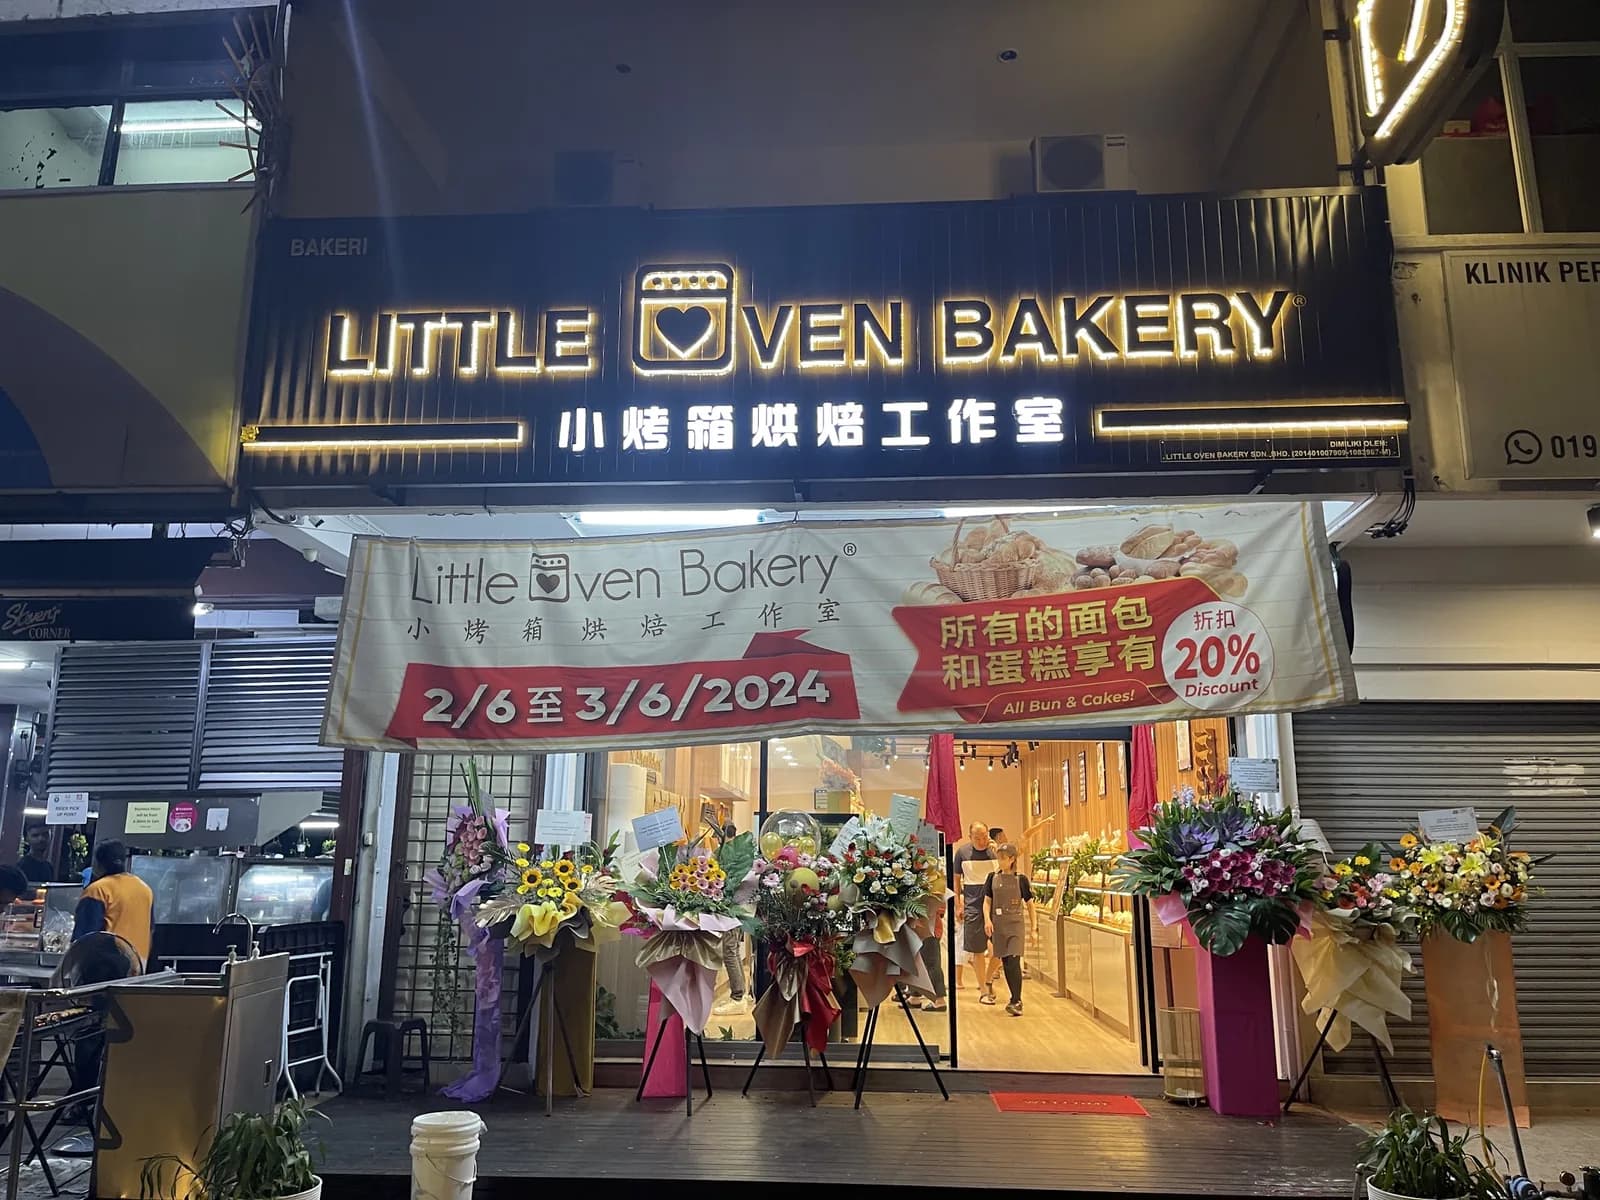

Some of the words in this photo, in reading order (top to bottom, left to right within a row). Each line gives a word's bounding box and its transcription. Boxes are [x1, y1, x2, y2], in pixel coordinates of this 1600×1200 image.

[290, 237, 368, 257] BAKERI
[1465, 261, 1551, 284] KLINIK
[327, 307, 592, 375] LITTLE
[558, 397, 1064, 452] 小烤箱烘焙工作室
[1165, 452, 1192, 460] LITTLE
[1193, 452, 1216, 460] OVEN
[1216, 451, 1249, 459] BAKERY
[1329, 440, 1362, 448] DIMILIKI
[1550, 434, 1598, 458] 019
[411, 556, 518, 605] Little
[28, 626, 72, 640] CORNER
[407, 598, 841, 645] 小烤箱烘焙工作室
[939, 596, 1154, 649] 所有的面包
[1192, 608, 1236, 631] 折扣
[941, 634, 1158, 691] 和蛋糕享有
[1173, 632, 1261, 680] 20%
[421, 683, 517, 729] 2/6
[526, 686, 565, 724] 至
[575, 669, 830, 725] 3/6/2024
[1002, 700, 1026, 716] All
[1029, 697, 1062, 712] Bun
[1066, 697, 1078, 709] &
[1084, 688, 1136, 706] Cakes!
[1184, 679, 1259, 698] Discount
